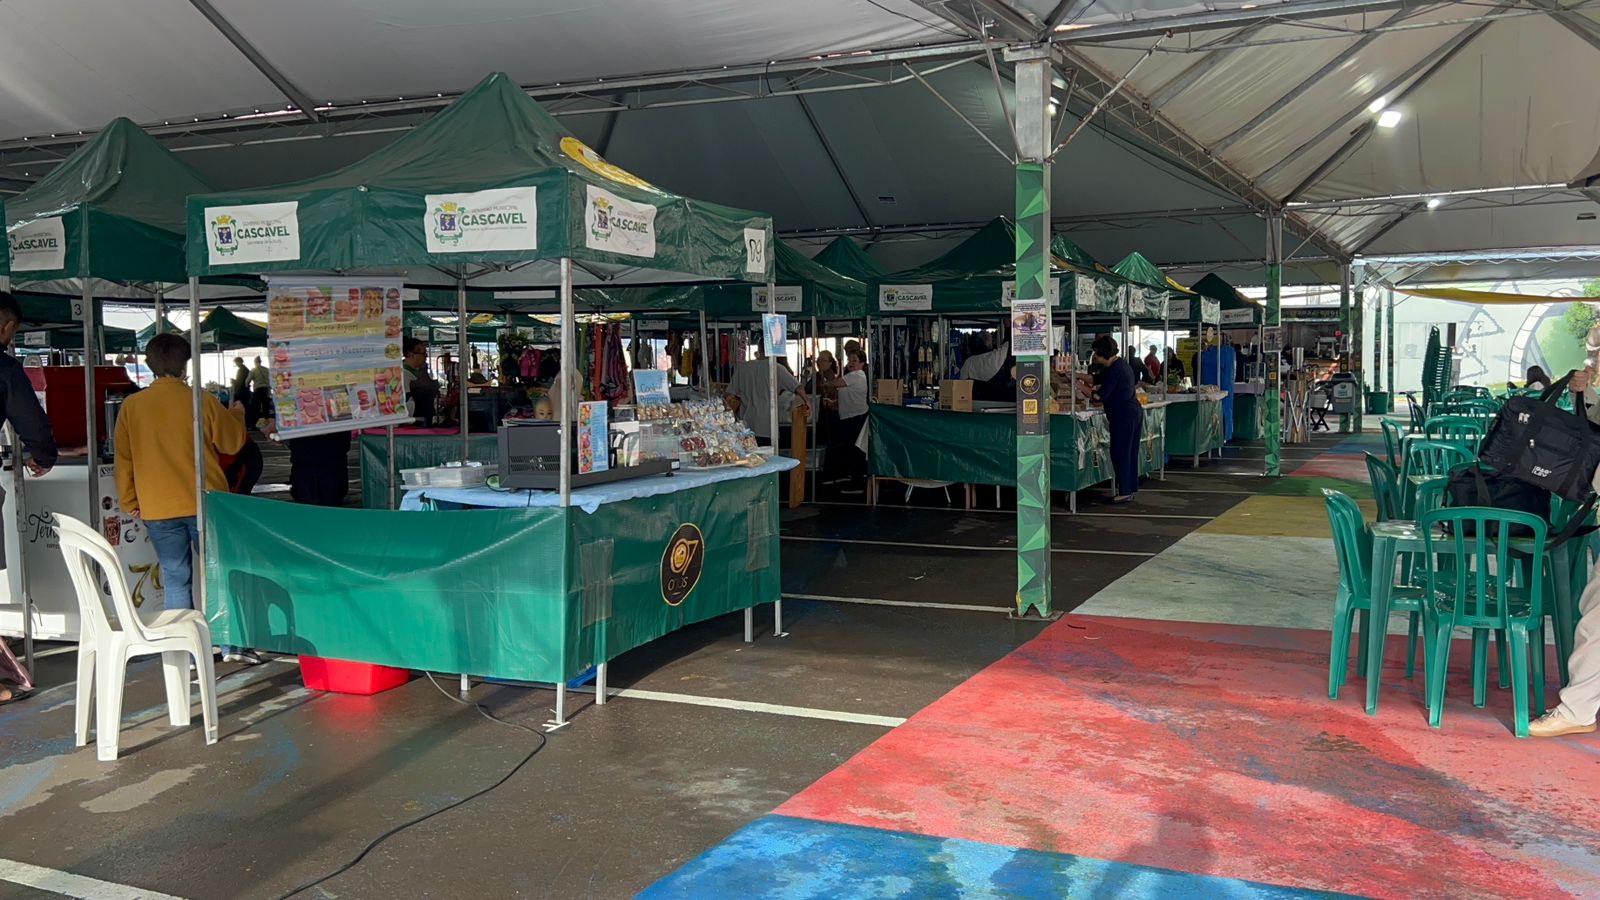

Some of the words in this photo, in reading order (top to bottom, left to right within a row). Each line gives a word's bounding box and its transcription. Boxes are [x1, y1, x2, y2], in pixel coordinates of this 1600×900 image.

[462, 213, 527, 226] CASCAVEL
[611, 217, 649, 234] CASCAVEL
[237, 226, 290, 240] CASCAVEL
[13, 238, 58, 250] CASCAVEL
